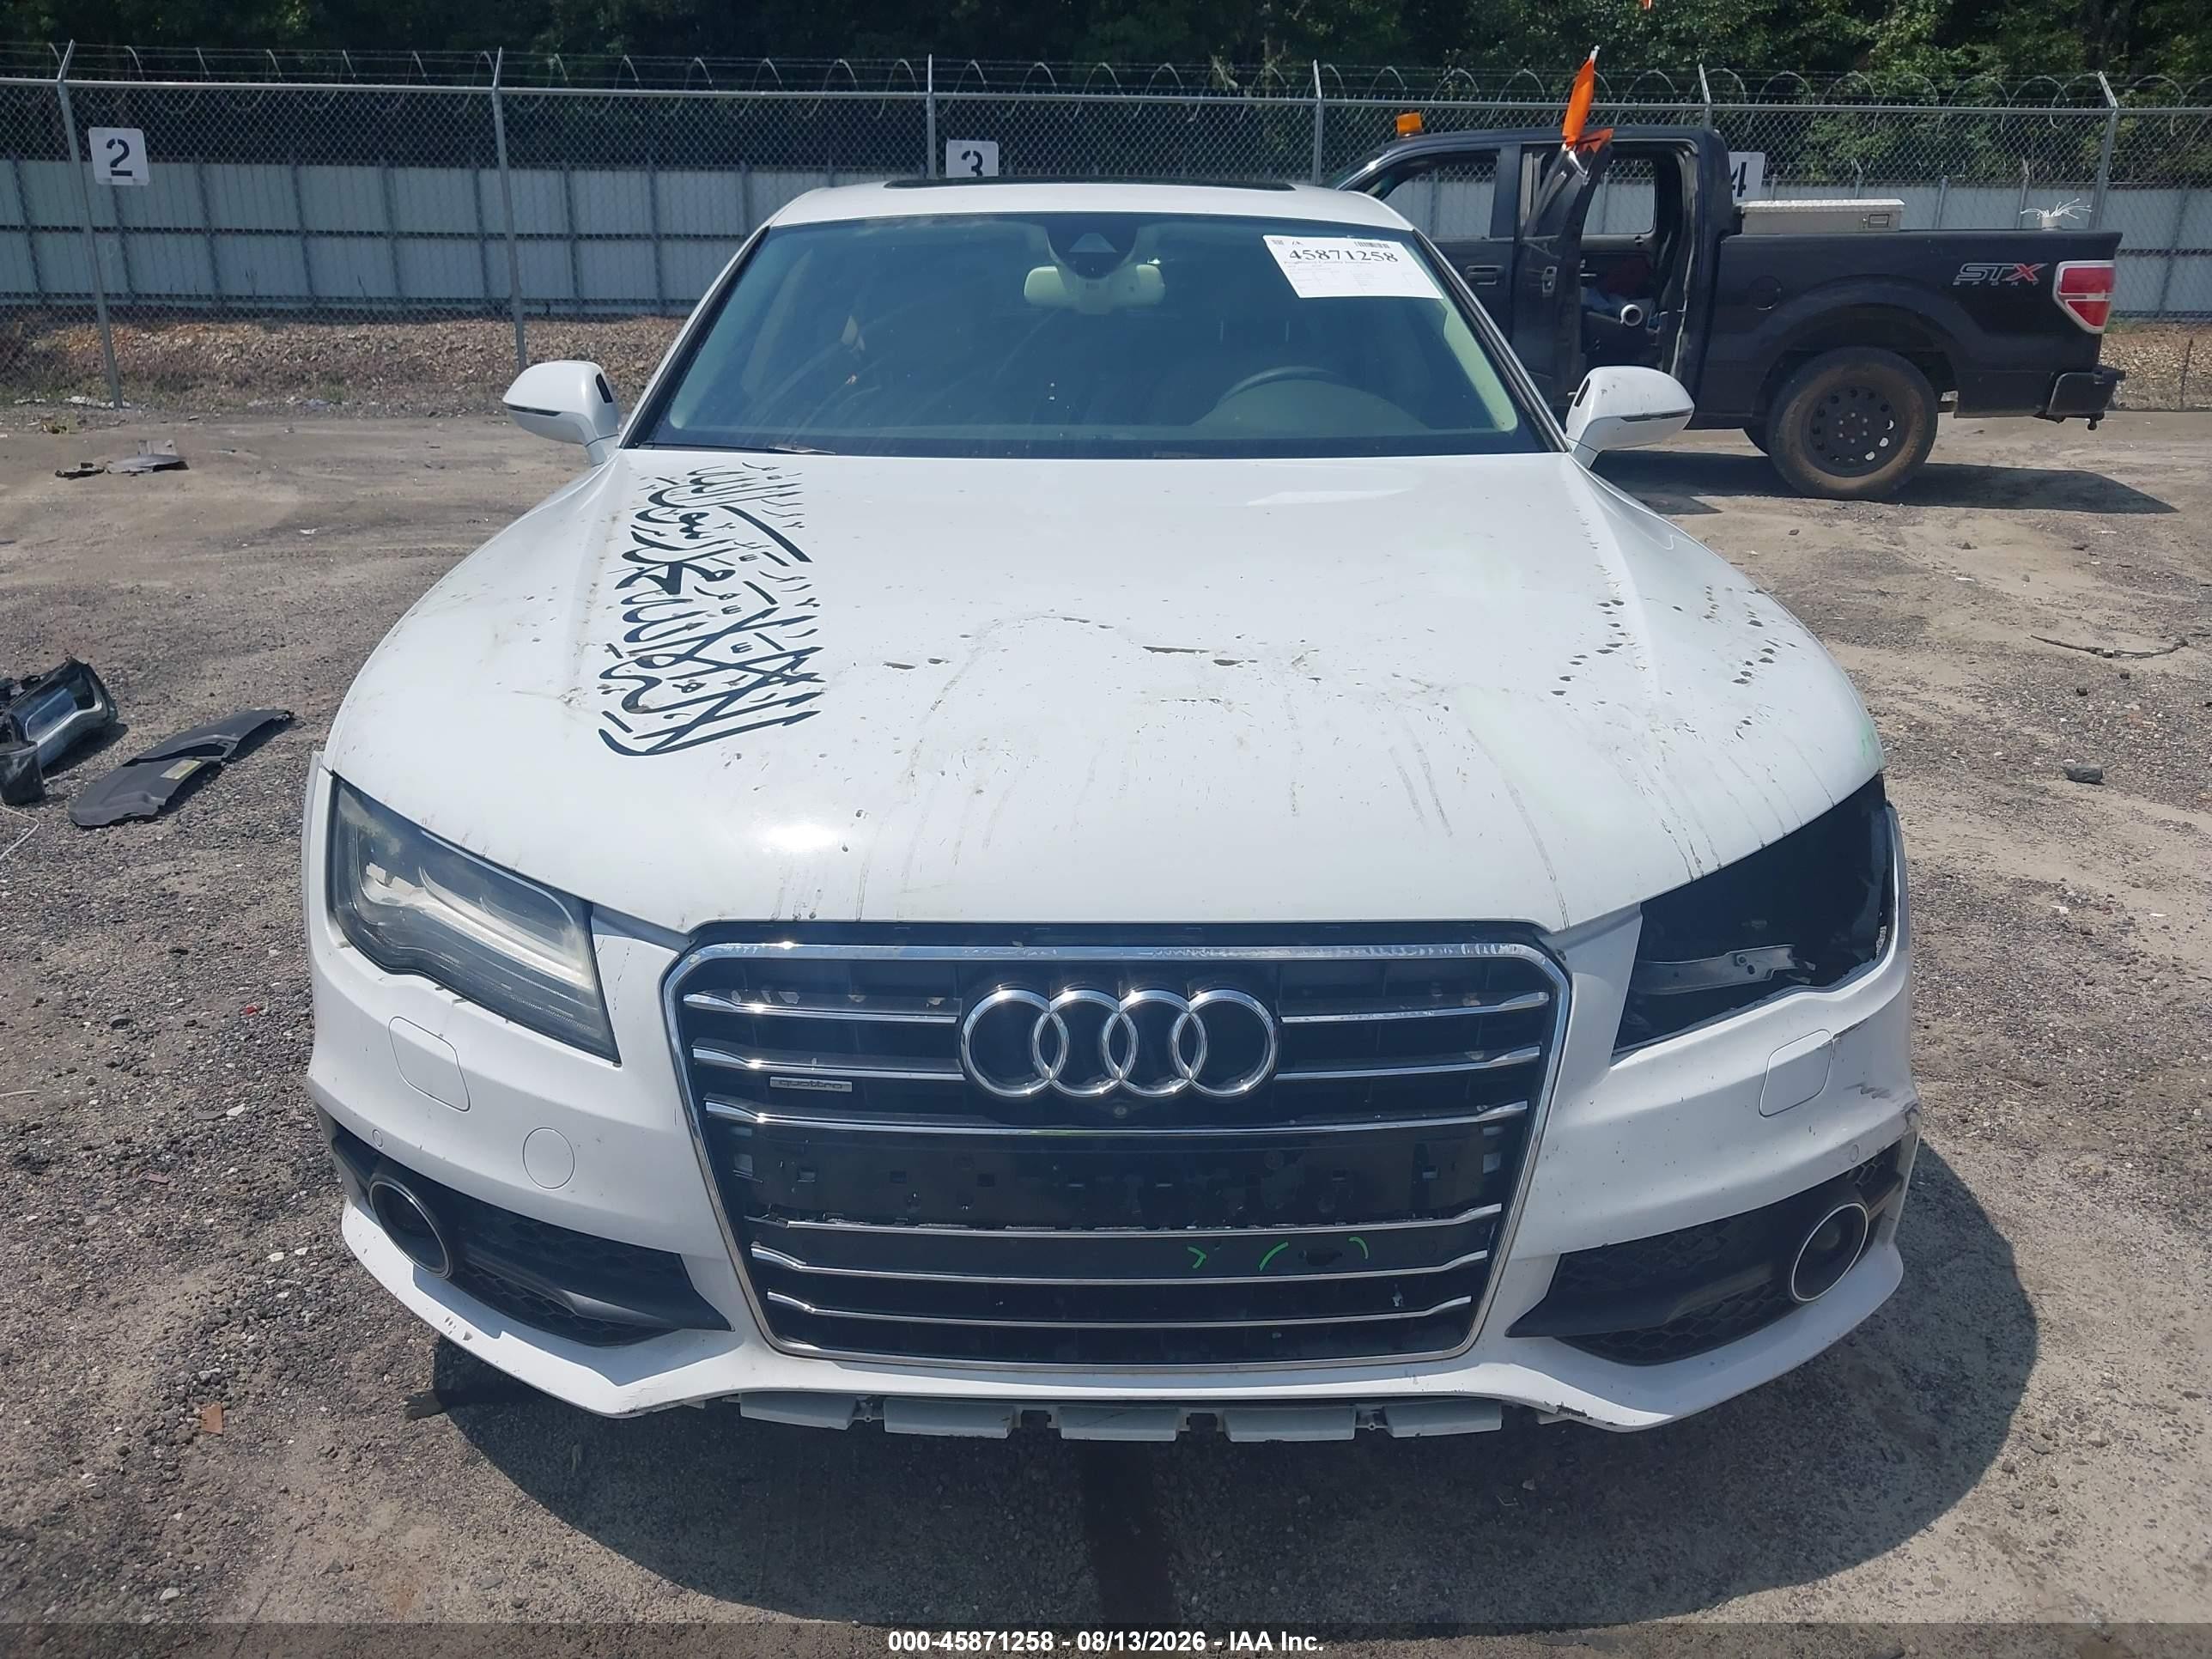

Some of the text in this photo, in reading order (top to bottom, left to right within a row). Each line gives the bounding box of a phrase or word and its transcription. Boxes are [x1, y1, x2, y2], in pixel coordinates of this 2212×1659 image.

[106, 138, 133, 177] 2
[961, 149, 983, 177] 3
[1730, 161, 1747, 198] 4
[1289, 249, 1399, 263] 45871258
[1954, 262, 2049, 282] STX
[779, 1079, 843, 1090] quattro
